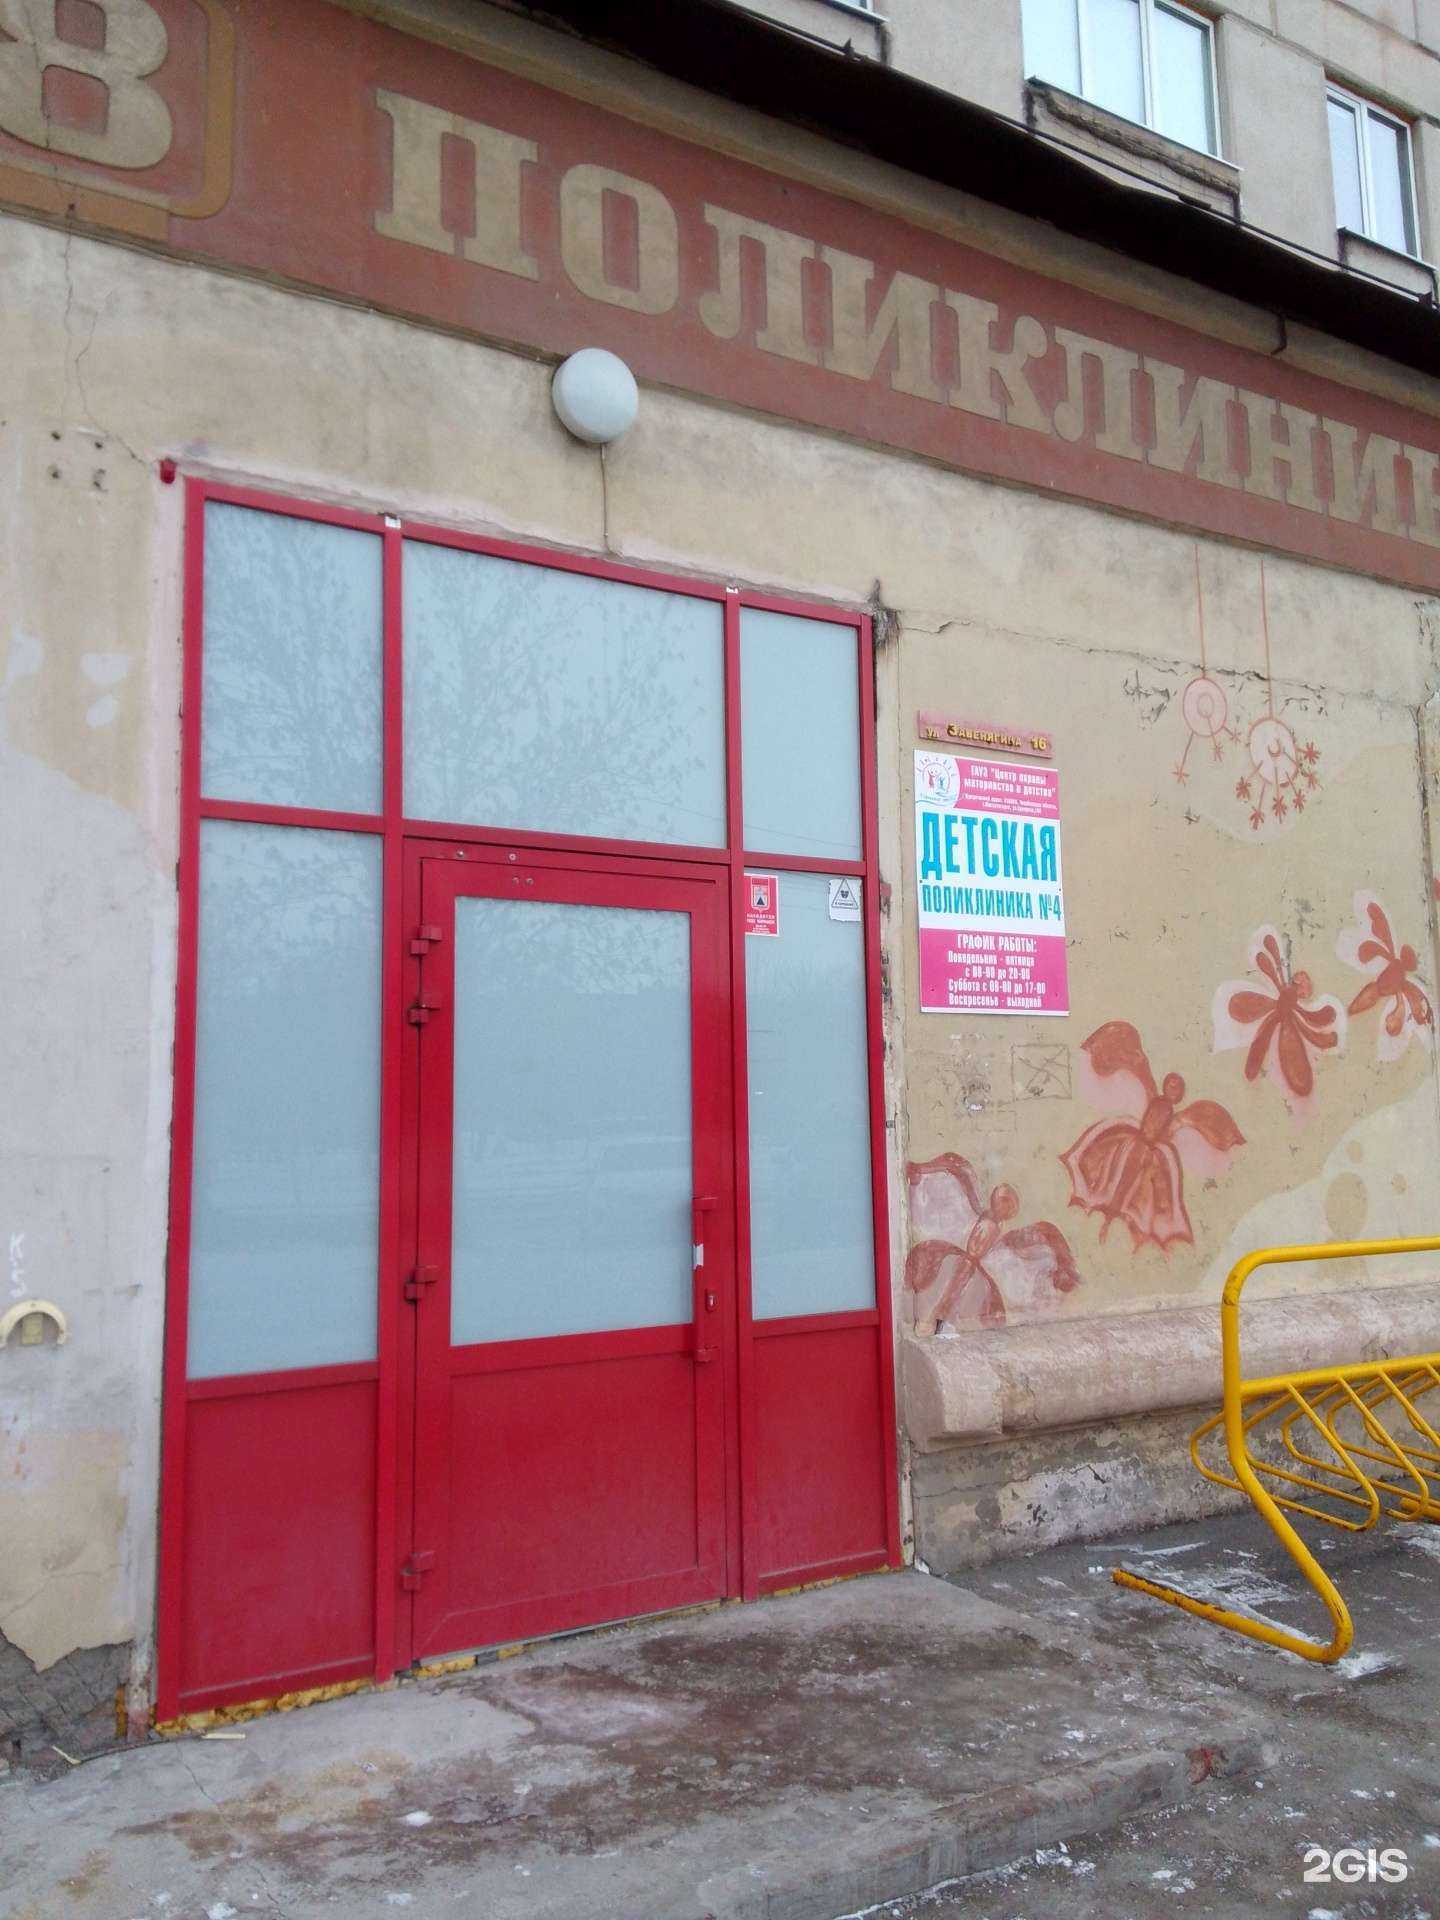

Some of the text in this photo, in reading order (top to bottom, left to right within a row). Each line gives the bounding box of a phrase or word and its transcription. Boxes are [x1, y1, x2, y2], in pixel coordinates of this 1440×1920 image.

[1031, 736, 1047, 750] 16
[921, 811, 1058, 881] ДЕТСКАЯ
[922, 884, 1062, 921] ПОЛИКЛИНИКА №4
[957, 933, 1038, 953] ГРАФИК РАБОТЫ:
[947, 950, 998, 966] Понедельник
[997, 968, 1007, 981] до
[948, 978, 981, 993] Суббота
[1013, 982, 1023, 995] до
[948, 992, 999, 1009] Воскресенье
